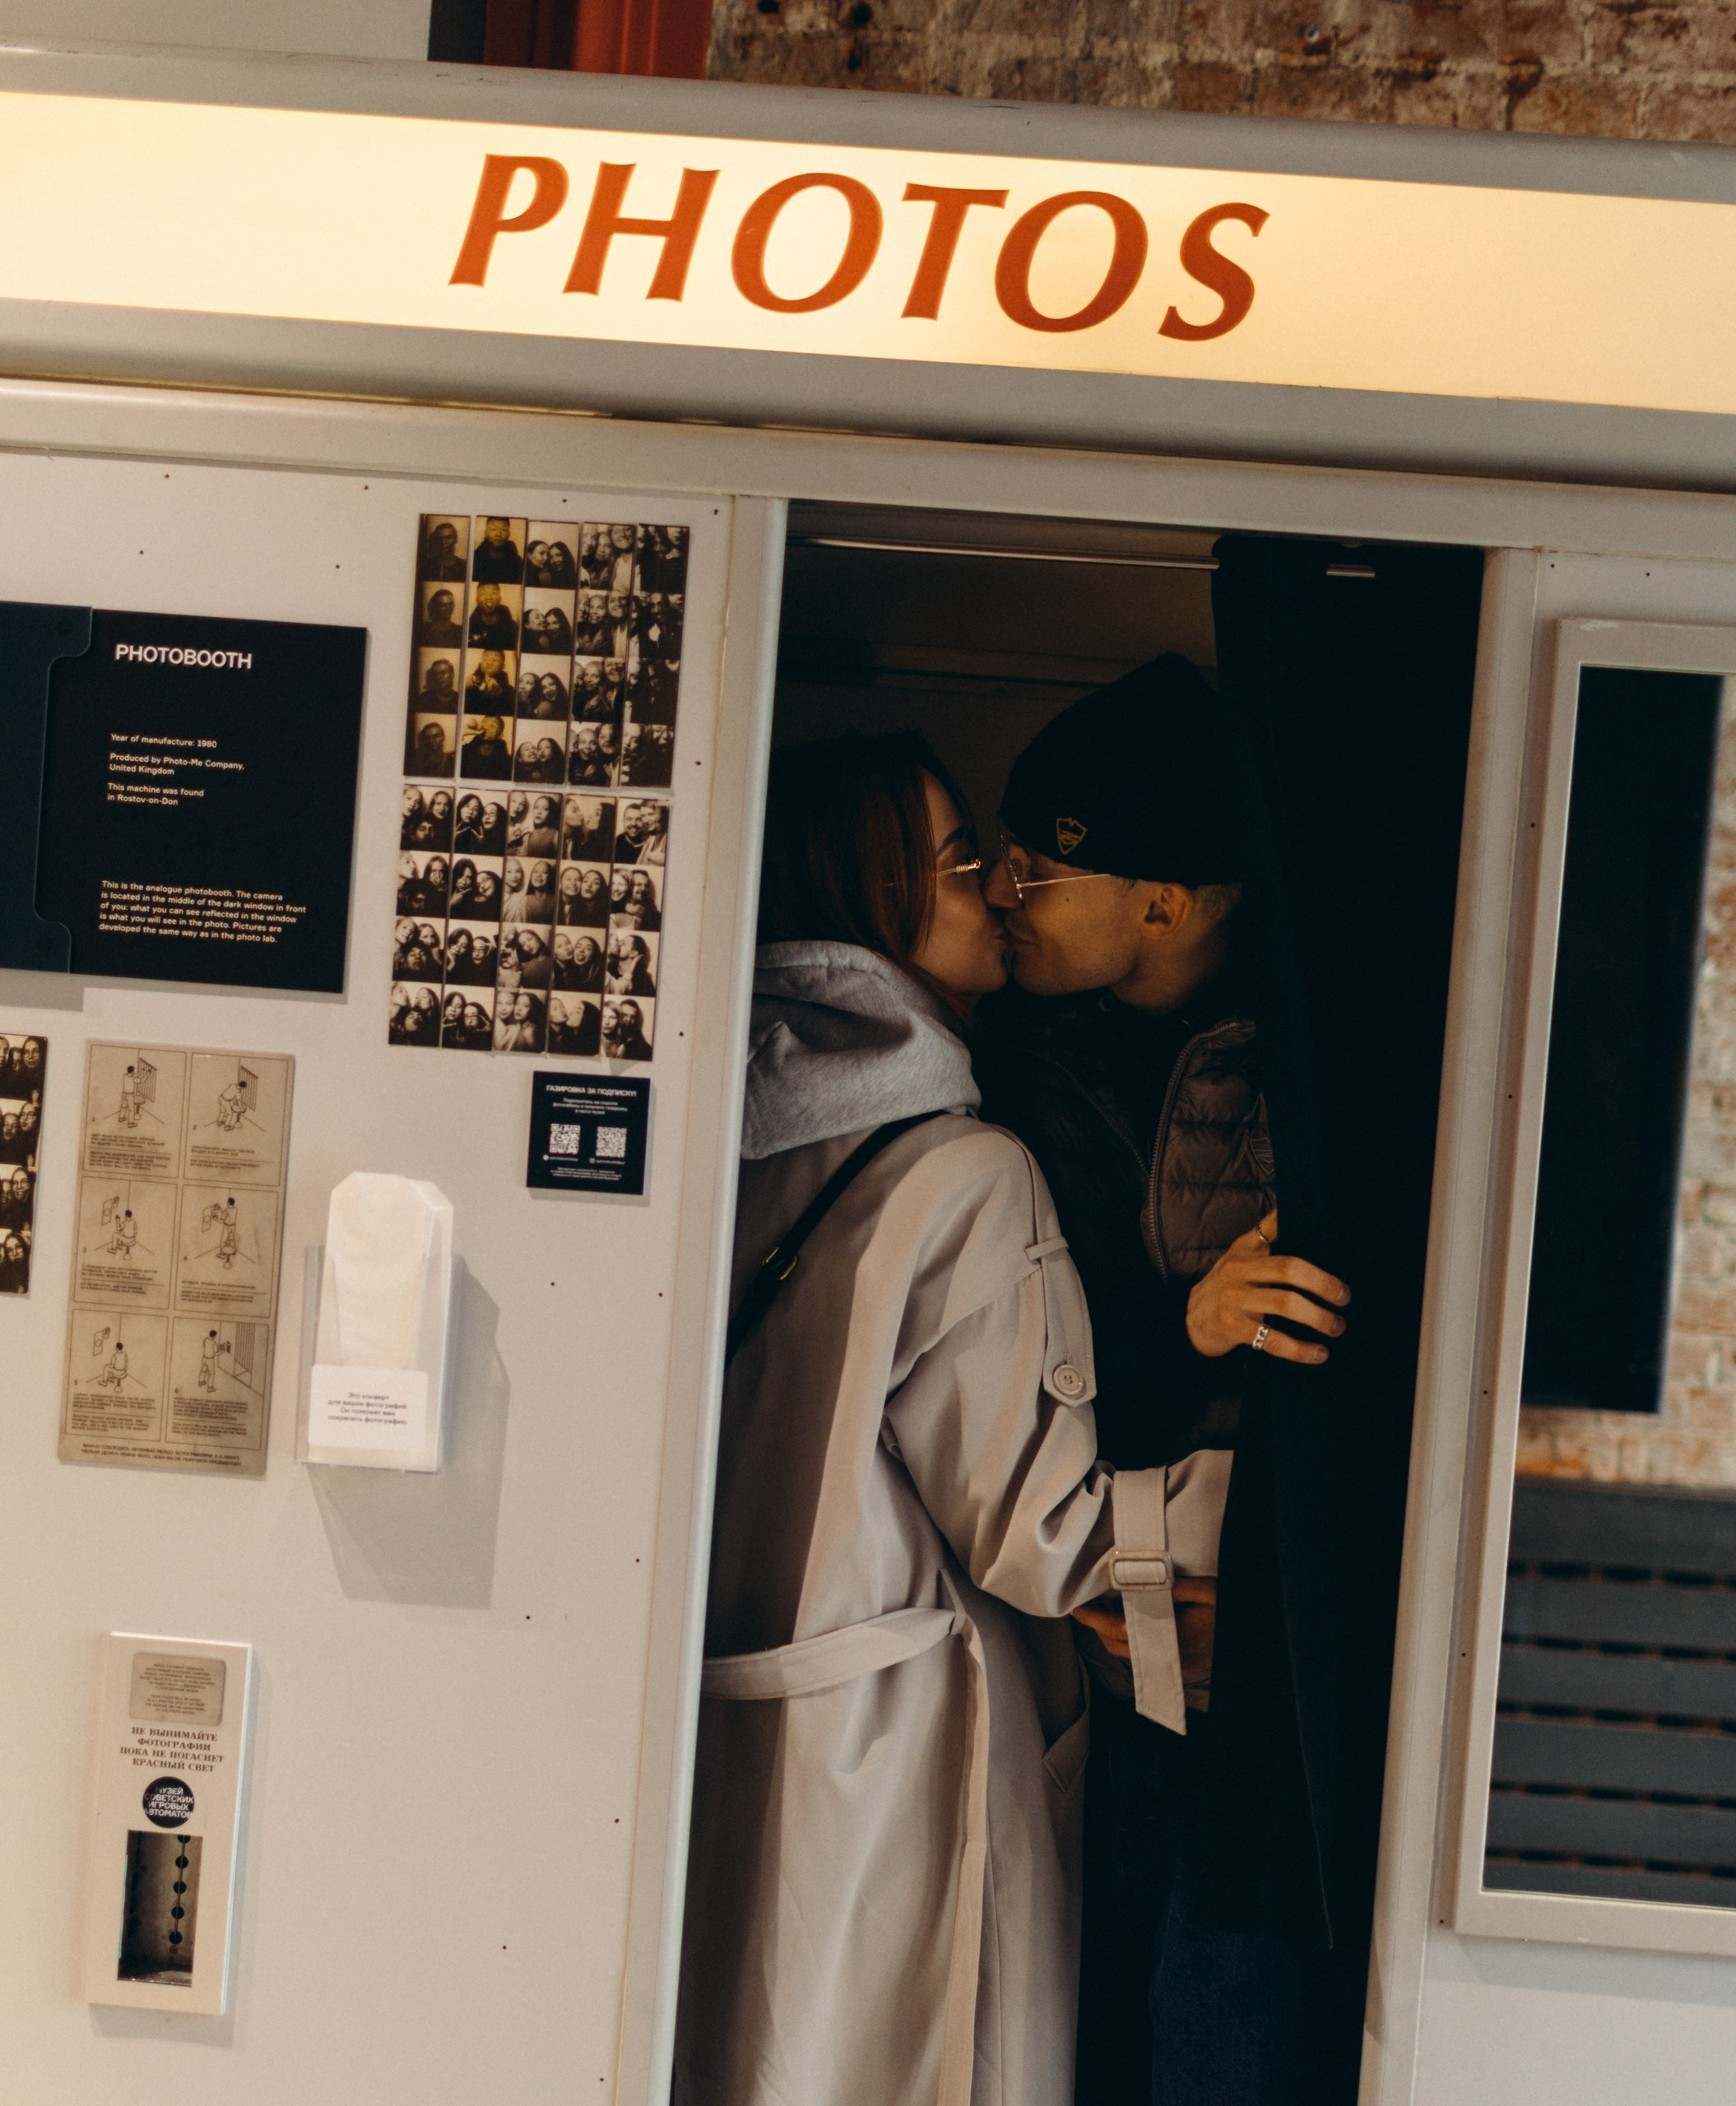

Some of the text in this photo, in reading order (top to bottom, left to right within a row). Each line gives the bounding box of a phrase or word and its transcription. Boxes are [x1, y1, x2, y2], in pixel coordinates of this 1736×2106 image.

[448, 152, 1271, 342] PHOTOS
[115, 644, 253, 669] PHOTOBOOTH
[110, 733, 217, 749] Year of manufacture: 1980
[109, 752, 244, 771] Produced by Photo-Me Company,
[109, 763, 174, 776] United Kingdom
[108, 782, 125, 791] This
[127, 785, 161, 794] machine
[180, 787, 205, 797] found
[117, 794, 179, 805] Rostov-on-Don
[102, 880, 119, 889] This
[129, 883, 144, 891] the
[145, 884, 183, 894] analogue
[184, 887, 234, 897] photobooth.
[236, 890, 252, 899] The
[253, 893, 283, 901] camera
[100, 891, 109, 899] is
[109, 892, 141, 901] located
[151, 895, 166, 903] the
[168, 897, 195, 905] middle
[207, 899, 222, 907] the
[223, 900, 242, 908] dark
[244, 902, 275, 911] window
[285, 904, 307, 913] front
[111, 904, 128, 912] you:
[130, 904, 151, 912] what
[151, 907, 167, 915] you
[202, 909, 239, 919] reflected
[250, 912, 265, 921] the
[266, 914, 297, 923] window
[108, 913, 128, 921] what
[130, 916, 146, 924] you
[146, 916, 161, 924] will
[188, 919, 203, 927] the
[204, 920, 230, 929] photo.
[232, 921, 267, 932] Pictures
[99, 922, 142, 934] developed
[142, 925, 156, 934] the
[158, 928, 180, 936] same
[181, 930, 198, 939] way
[220, 931, 234, 939] the
[236, 933, 261, 942] photo
[262, 935, 277, 943] lab.
[545, 1084, 587, 1093] ГАЗИРОВКА
[596, 1088, 637, 1097] ПОДПИСКУ!
[132, 1727, 217, 1742] НЕ ВЫНИМАЙТЕ
[137, 1737, 211, 1751] ФОТОГРАФИИ
[120, 1746, 225, 1763] ПОКА НЕ ПОГАСНЕТ
[132, 1758, 215, 1772] КРАСНЫЙ СВЕТ
[149, 1801, 188, 1811] ИГРОВЫХ
